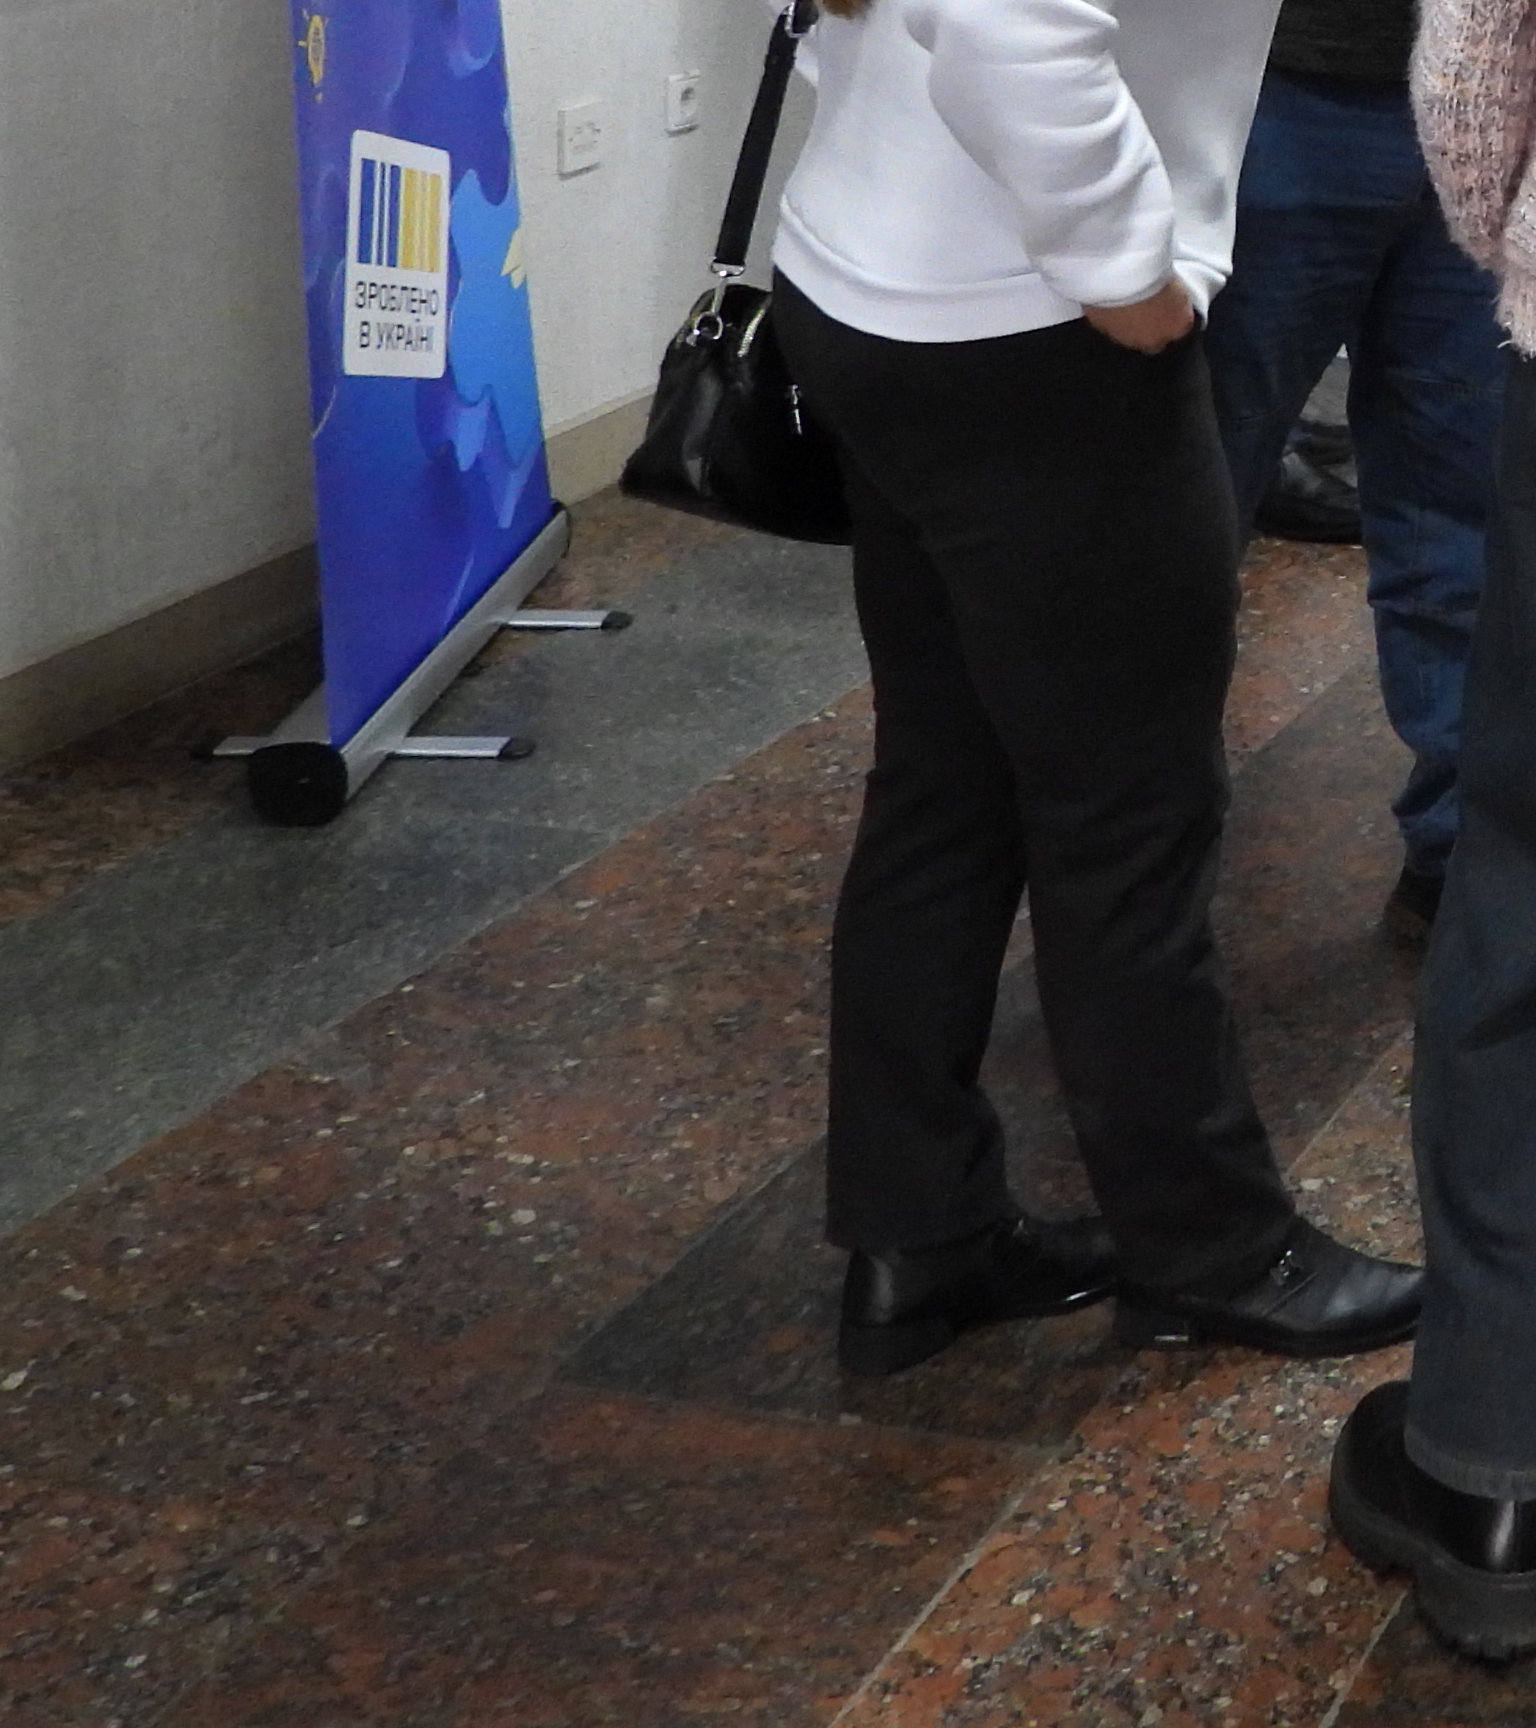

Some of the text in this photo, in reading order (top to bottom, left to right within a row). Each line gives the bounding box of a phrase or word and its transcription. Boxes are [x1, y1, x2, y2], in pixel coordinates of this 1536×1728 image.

[355, 280, 440, 315] ЗРОБЛЕНО
[359, 318, 434, 353] В УКРАЇНІ
